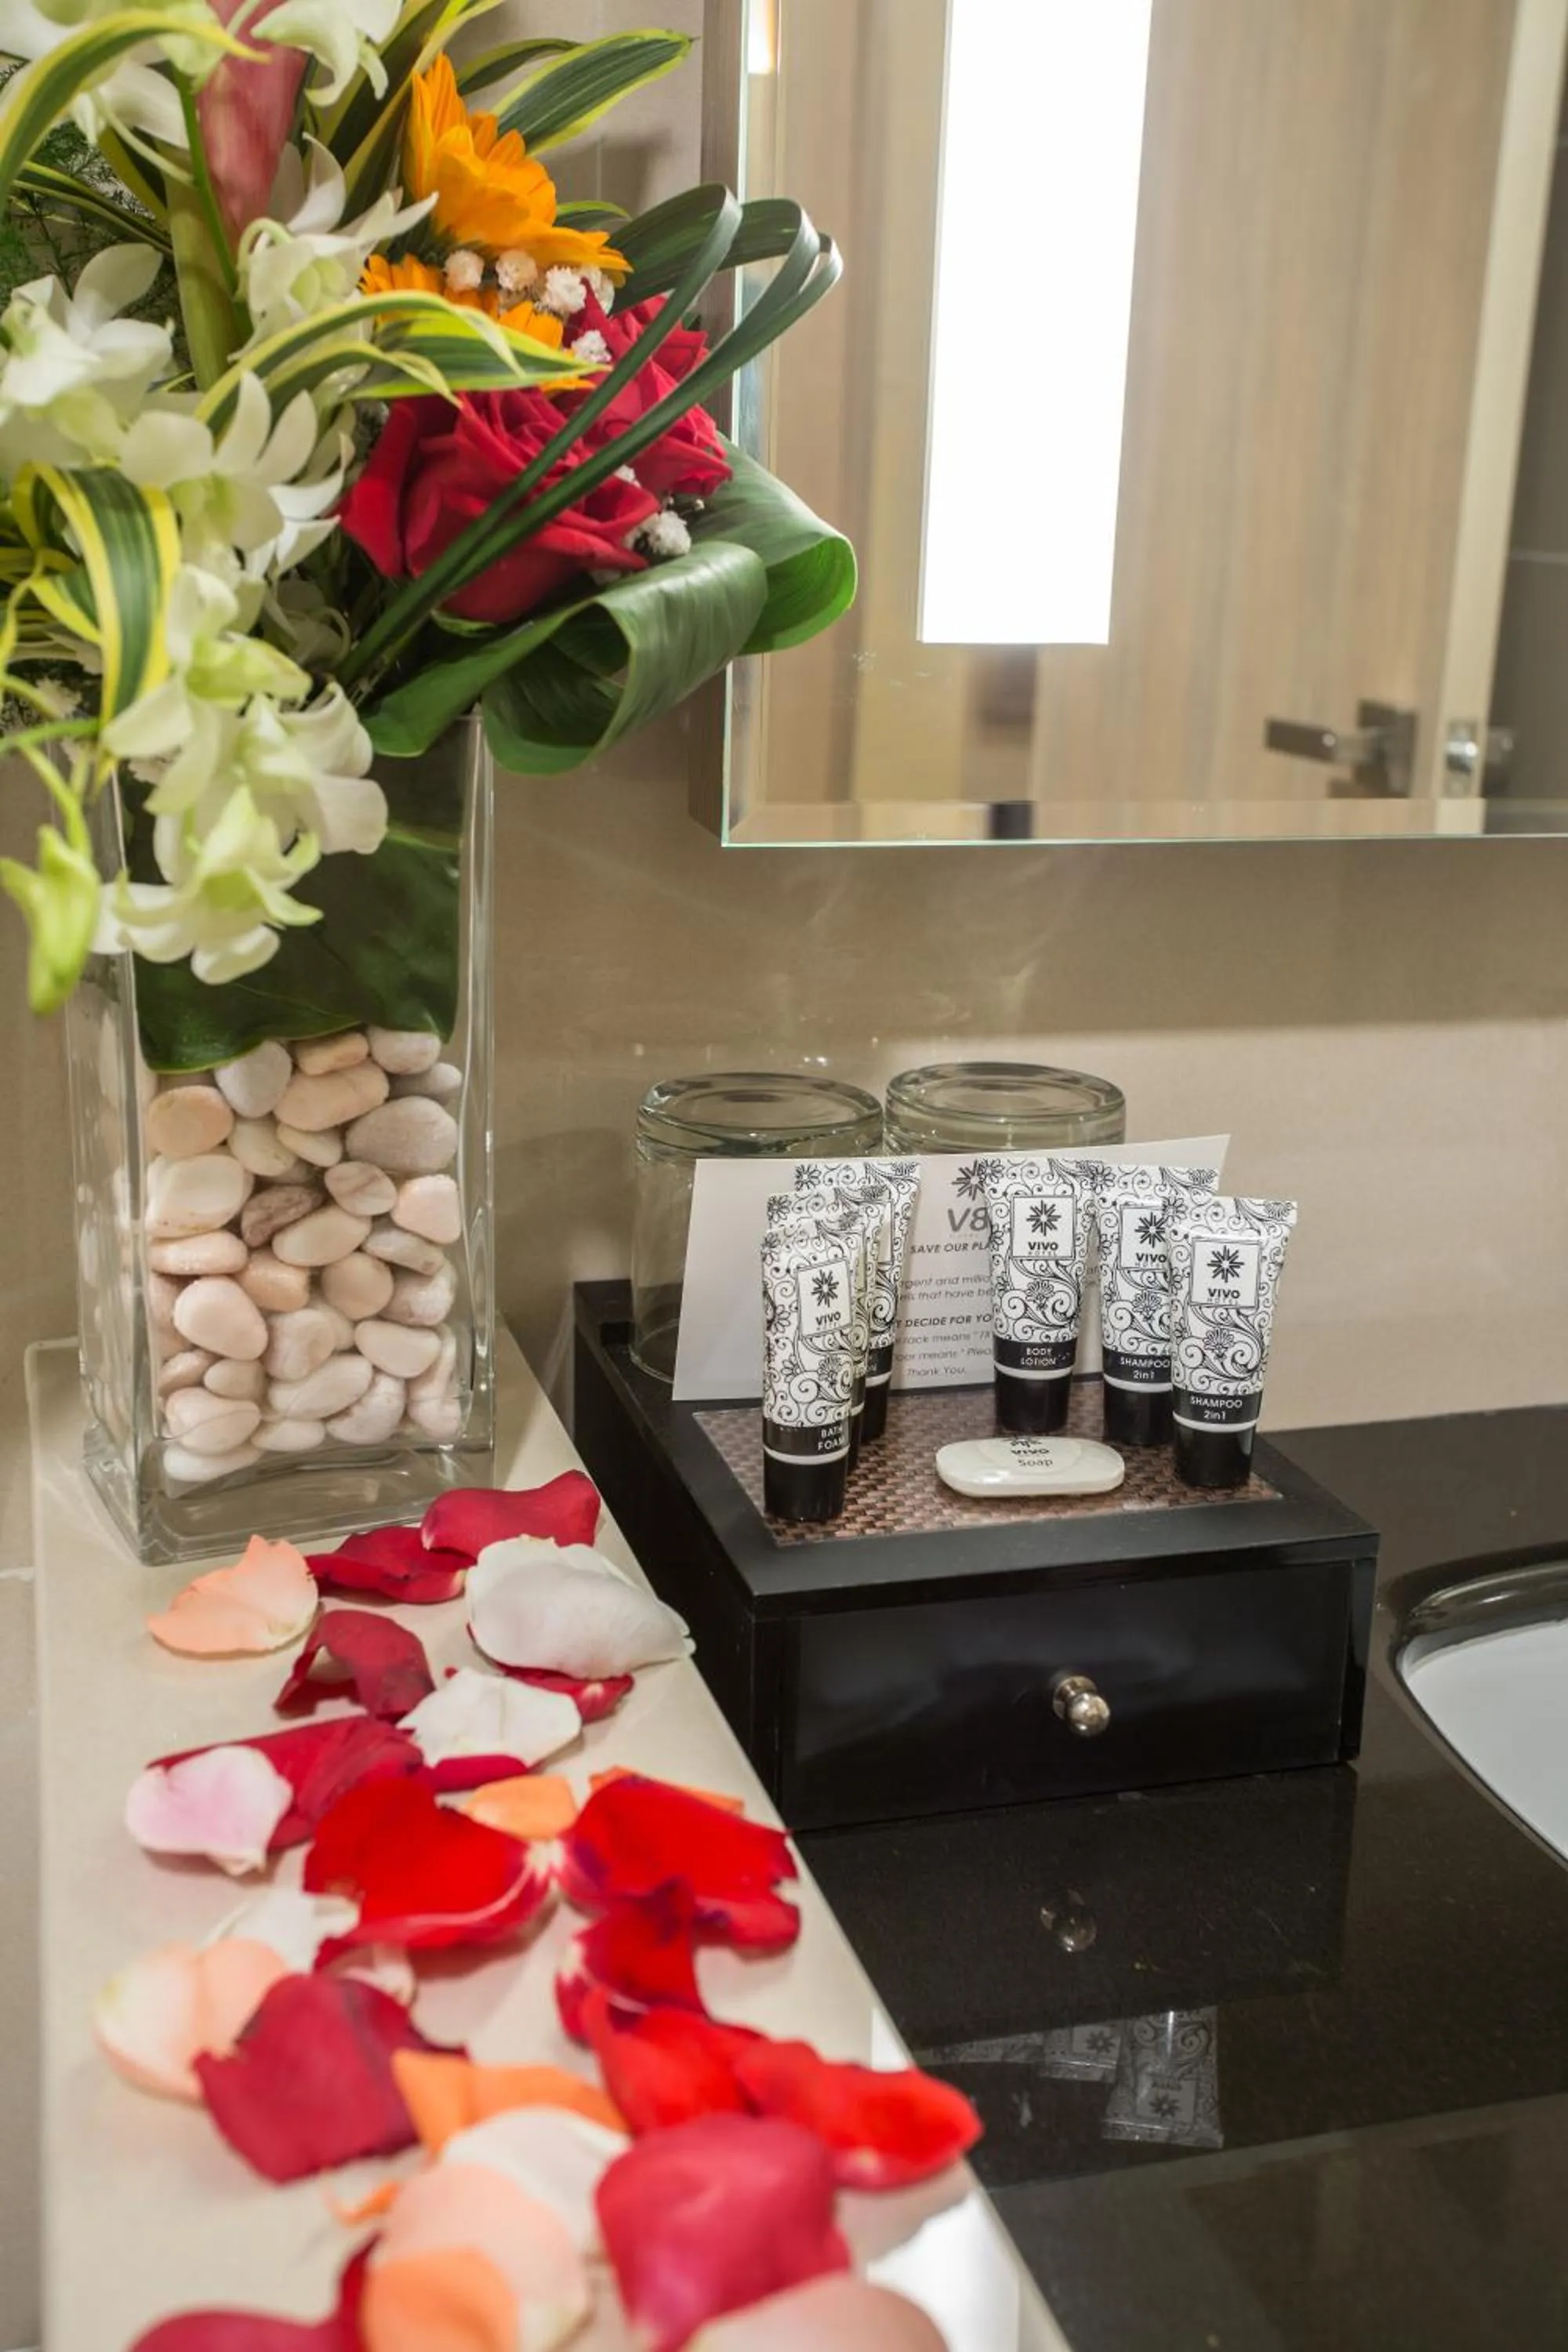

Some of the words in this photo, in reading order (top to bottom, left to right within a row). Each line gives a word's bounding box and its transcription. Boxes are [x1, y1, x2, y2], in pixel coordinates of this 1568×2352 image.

[910, 1244, 940, 1254] SAVE
[943, 1243, 968, 1253] OUR
[972, 1241, 989, 1250] PLA
[1028, 1241, 1059, 1250] VIVO
[1135, 1252, 1167, 1263] VIVO
[935, 1276, 959, 1286] and
[919, 1290, 942, 1300] that
[946, 1289, 974, 1298] have
[1208, 1288, 1240, 1298] VIVO
[815, 1311, 841, 1326] VIVO
[905, 1316, 946, 1328] DECIDE
[949, 1316, 971, 1325] FOR
[1026, 1347, 1053, 1356] BODY
[1021, 1357, 1056, 1367] LOTION
[1120, 1356, 1171, 1368] SHAMPOO
[908, 1367, 939, 1377] Thank
[1134, 1370, 1155, 1380] 2in1
[1190, 1396, 1243, 1409] SHAMPOO
[1203, 1410, 1226, 1420] 2in1
